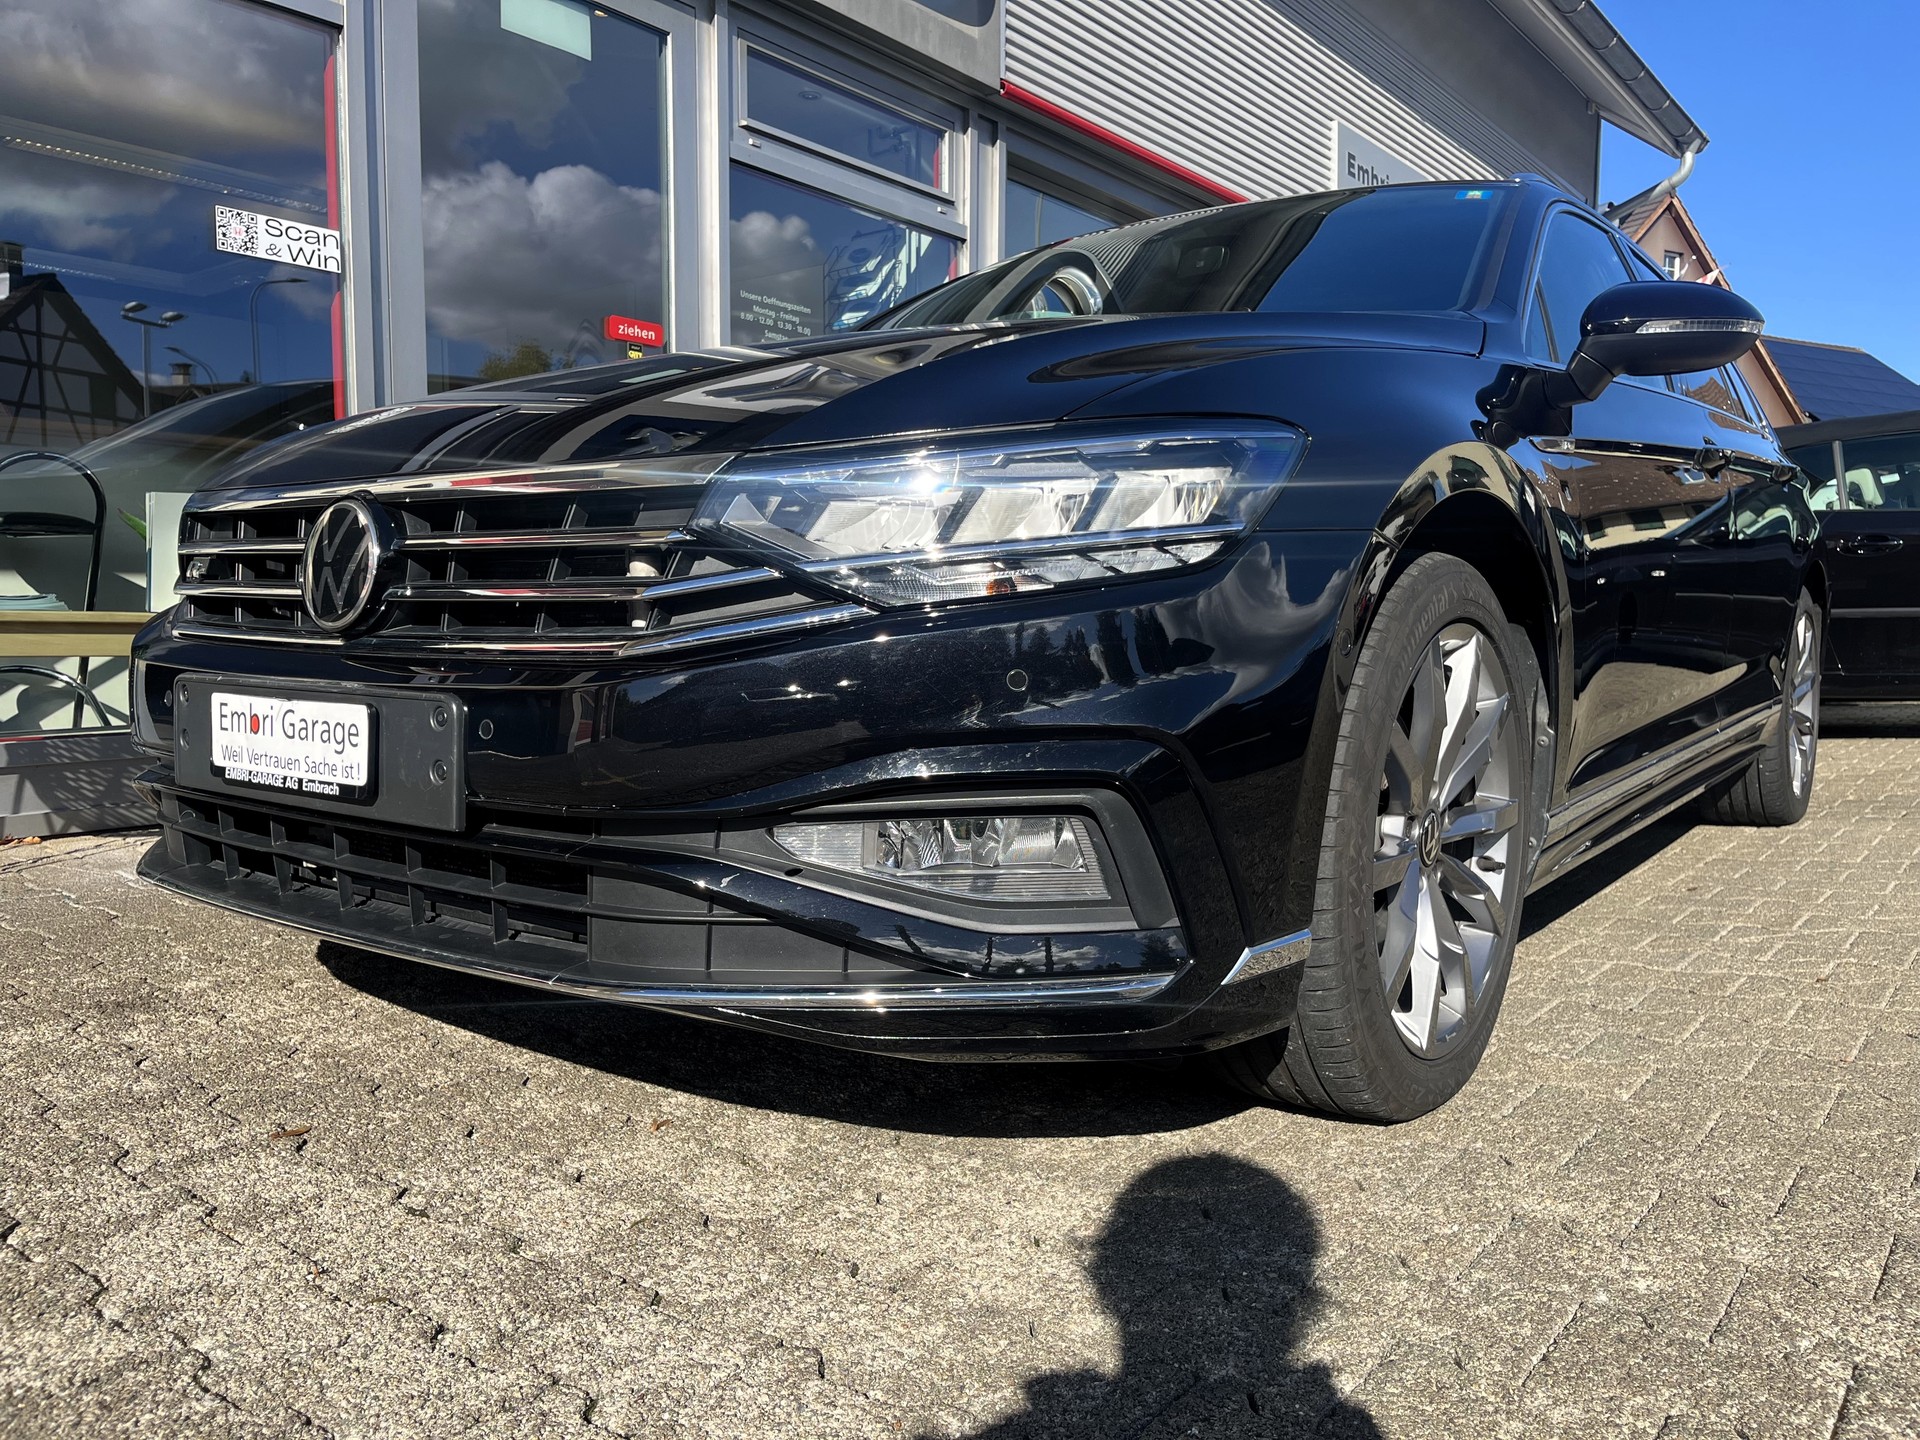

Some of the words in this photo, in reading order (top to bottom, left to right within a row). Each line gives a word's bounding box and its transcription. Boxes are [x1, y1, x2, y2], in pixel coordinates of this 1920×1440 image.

[1347, 151, 1390, 186] Emb
[265, 218, 339, 250] Scan
[265, 243, 282, 257] &
[287, 244, 341, 271] Win
[740, 290, 761, 302] Unsere
[763, 296, 811, 314] Oeffnungszeiten
[753, 305, 775, 318] Montag
[780, 312, 799, 324] Freitag
[618, 323, 655, 340] ziehen
[764, 330, 788, 340] Samsta
[219, 702, 275, 736] Embri
[282, 708, 360, 755] Garage
[221, 744, 244, 764] Weil
[246, 747, 301, 773] Vertrauen
[304, 755, 338, 778] Sache
[225, 767, 285, 788] EMBRI-GARAGE
[285, 777, 299, 790] AG
[302, 778, 341, 796] Embrach
